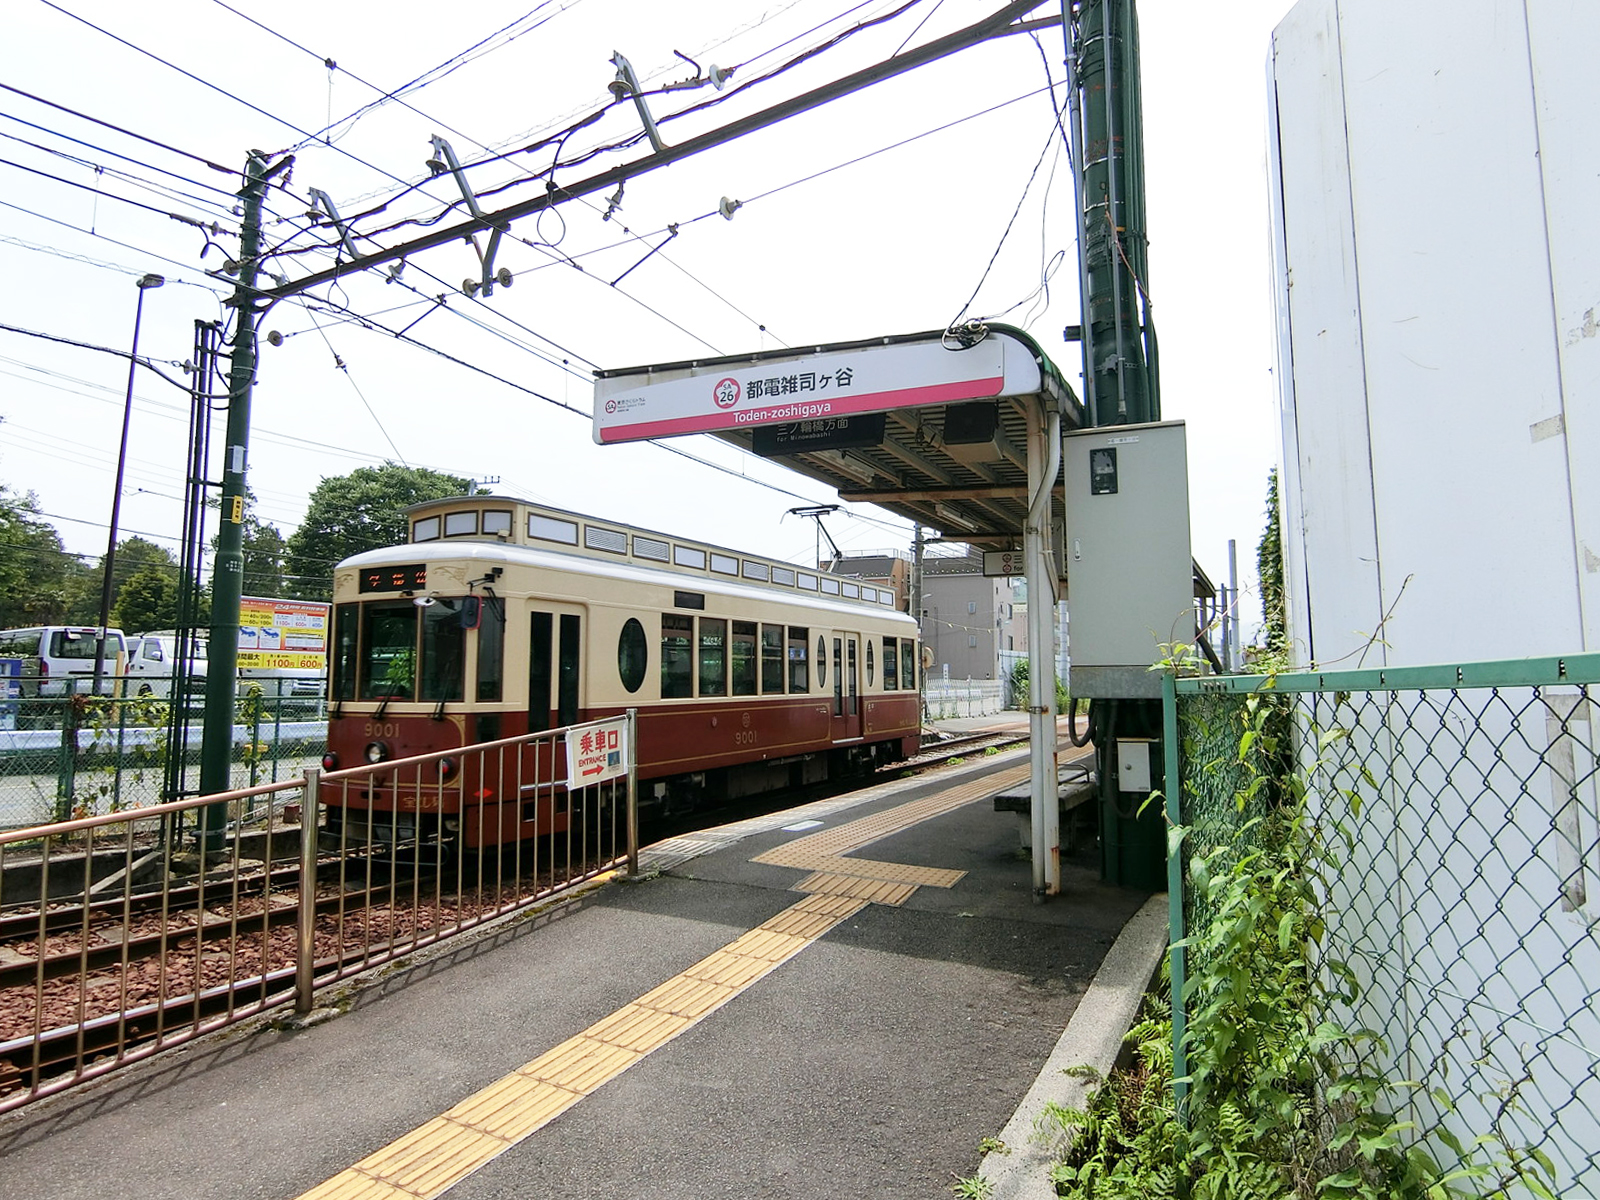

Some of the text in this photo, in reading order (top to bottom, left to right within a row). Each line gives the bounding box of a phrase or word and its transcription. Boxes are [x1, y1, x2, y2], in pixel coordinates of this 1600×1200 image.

[723, 383, 732, 391] SA
[720, 390, 734, 403] 26
[733, 402, 831, 423] Toden-zoshigaya
[776, 431, 831, 443] for Minowabashi
[365, 723, 400, 738] 9001
[735, 730, 757, 745] 9001
[579, 729, 618, 755] 乗車口
[578, 753, 607, 768] ENTRANCE
